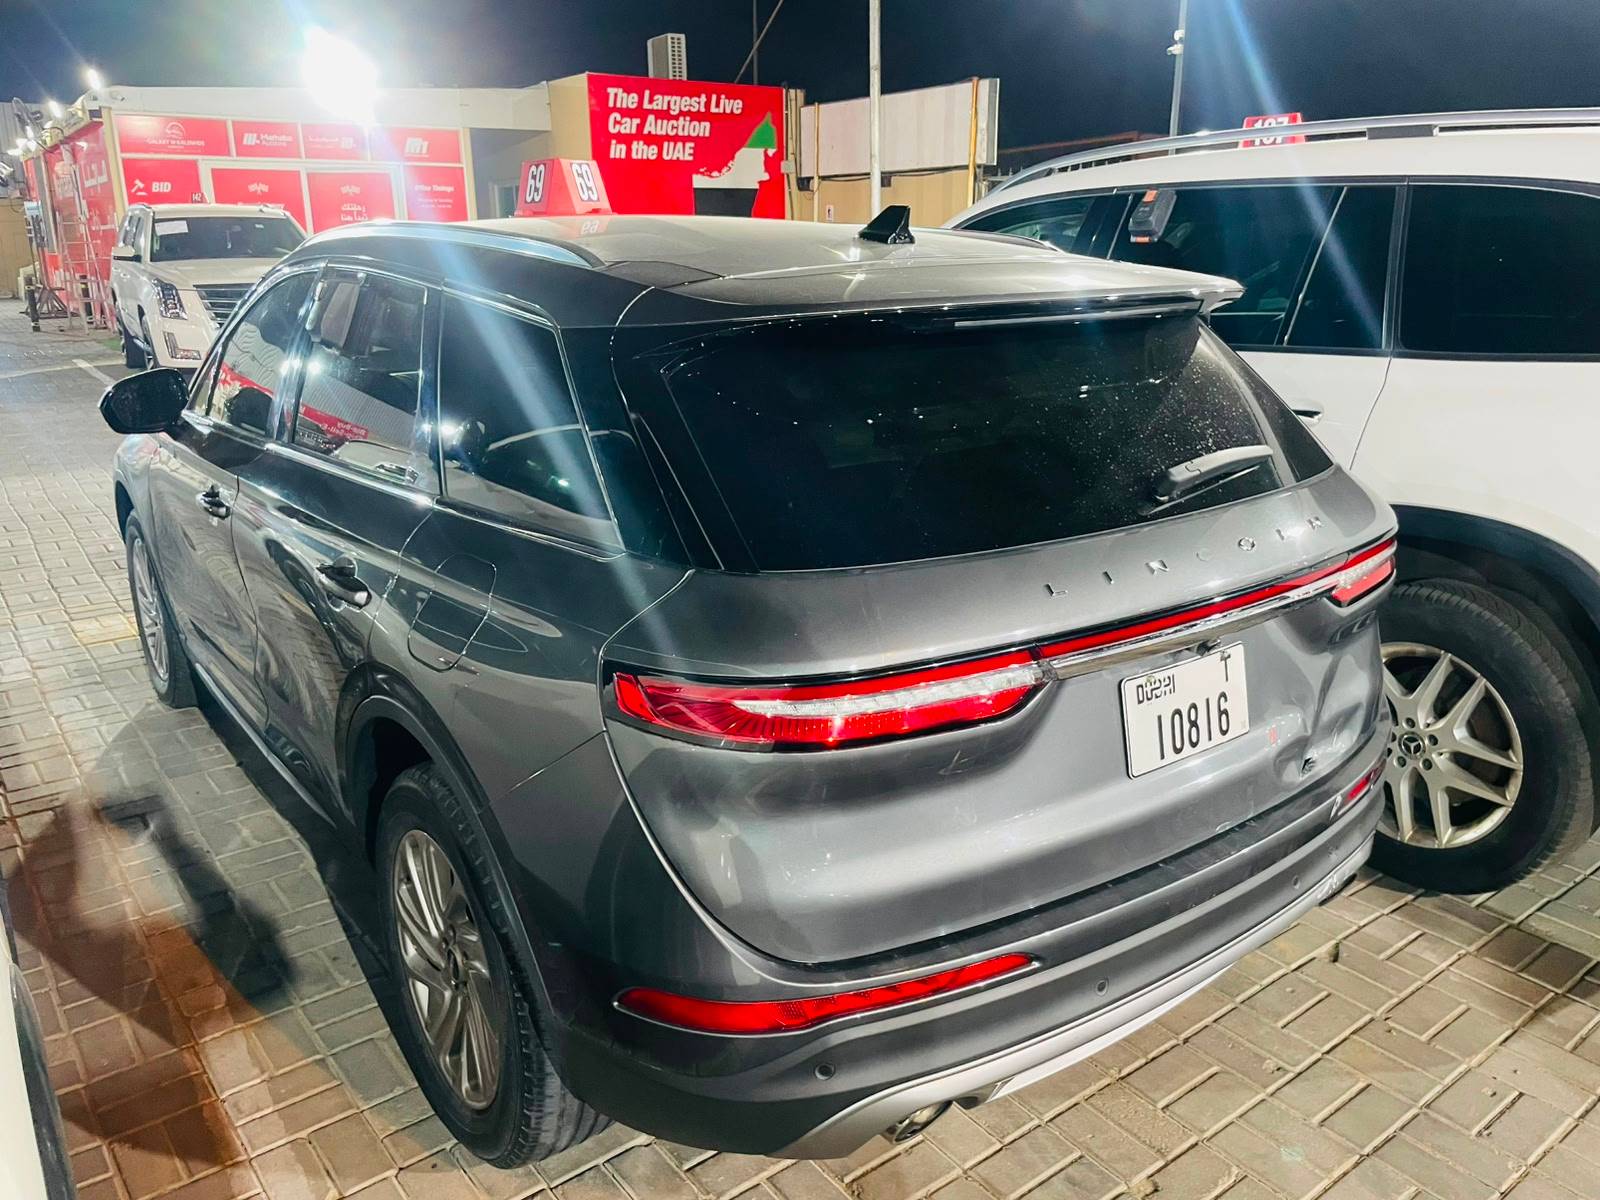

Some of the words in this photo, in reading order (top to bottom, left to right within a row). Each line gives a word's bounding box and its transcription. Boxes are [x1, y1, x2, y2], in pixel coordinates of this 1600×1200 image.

[607, 87, 638, 108] The
[643, 90, 707, 115] Largest
[710, 94, 743, 114] Live
[608, 112, 640, 134] Car
[643, 114, 711, 137] Auction
[609, 140, 626, 159] in
[631, 141, 658, 160] the
[662, 142, 695, 161] UAE
[151, 181, 172, 193] BID
[526, 164, 545, 203] 69
[571, 164, 599, 201] 69
[1157, 691, 1230, 760] 10816
